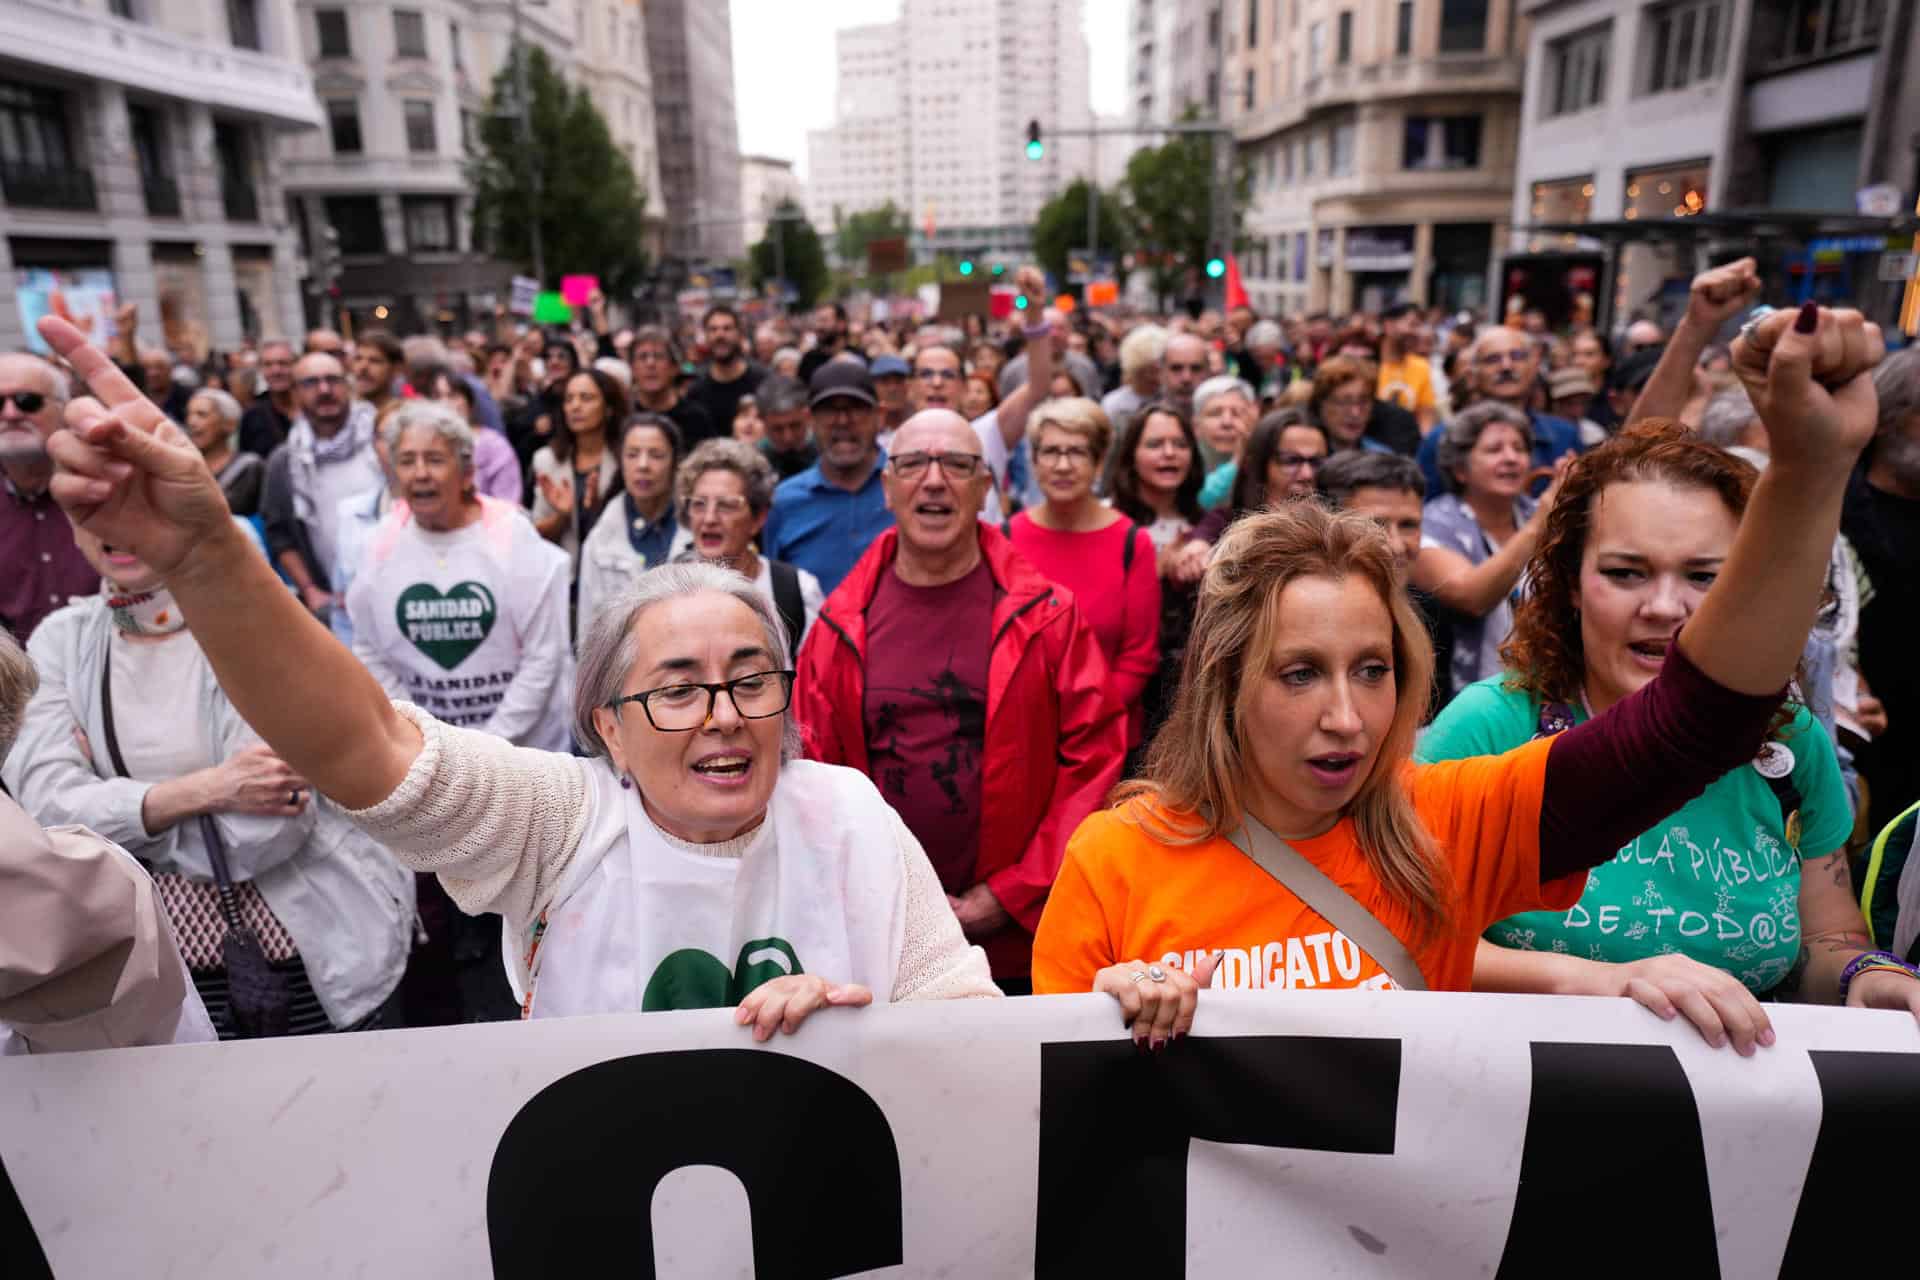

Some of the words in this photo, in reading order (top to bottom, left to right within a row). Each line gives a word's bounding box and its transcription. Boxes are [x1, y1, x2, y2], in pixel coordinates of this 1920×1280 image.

[405, 599, 482, 619] SANIDAD
[1687, 837, 1801, 886] PÚBLICA
[1563, 904, 1621, 935] DE
[1647, 906, 1799, 949] TOD@S
